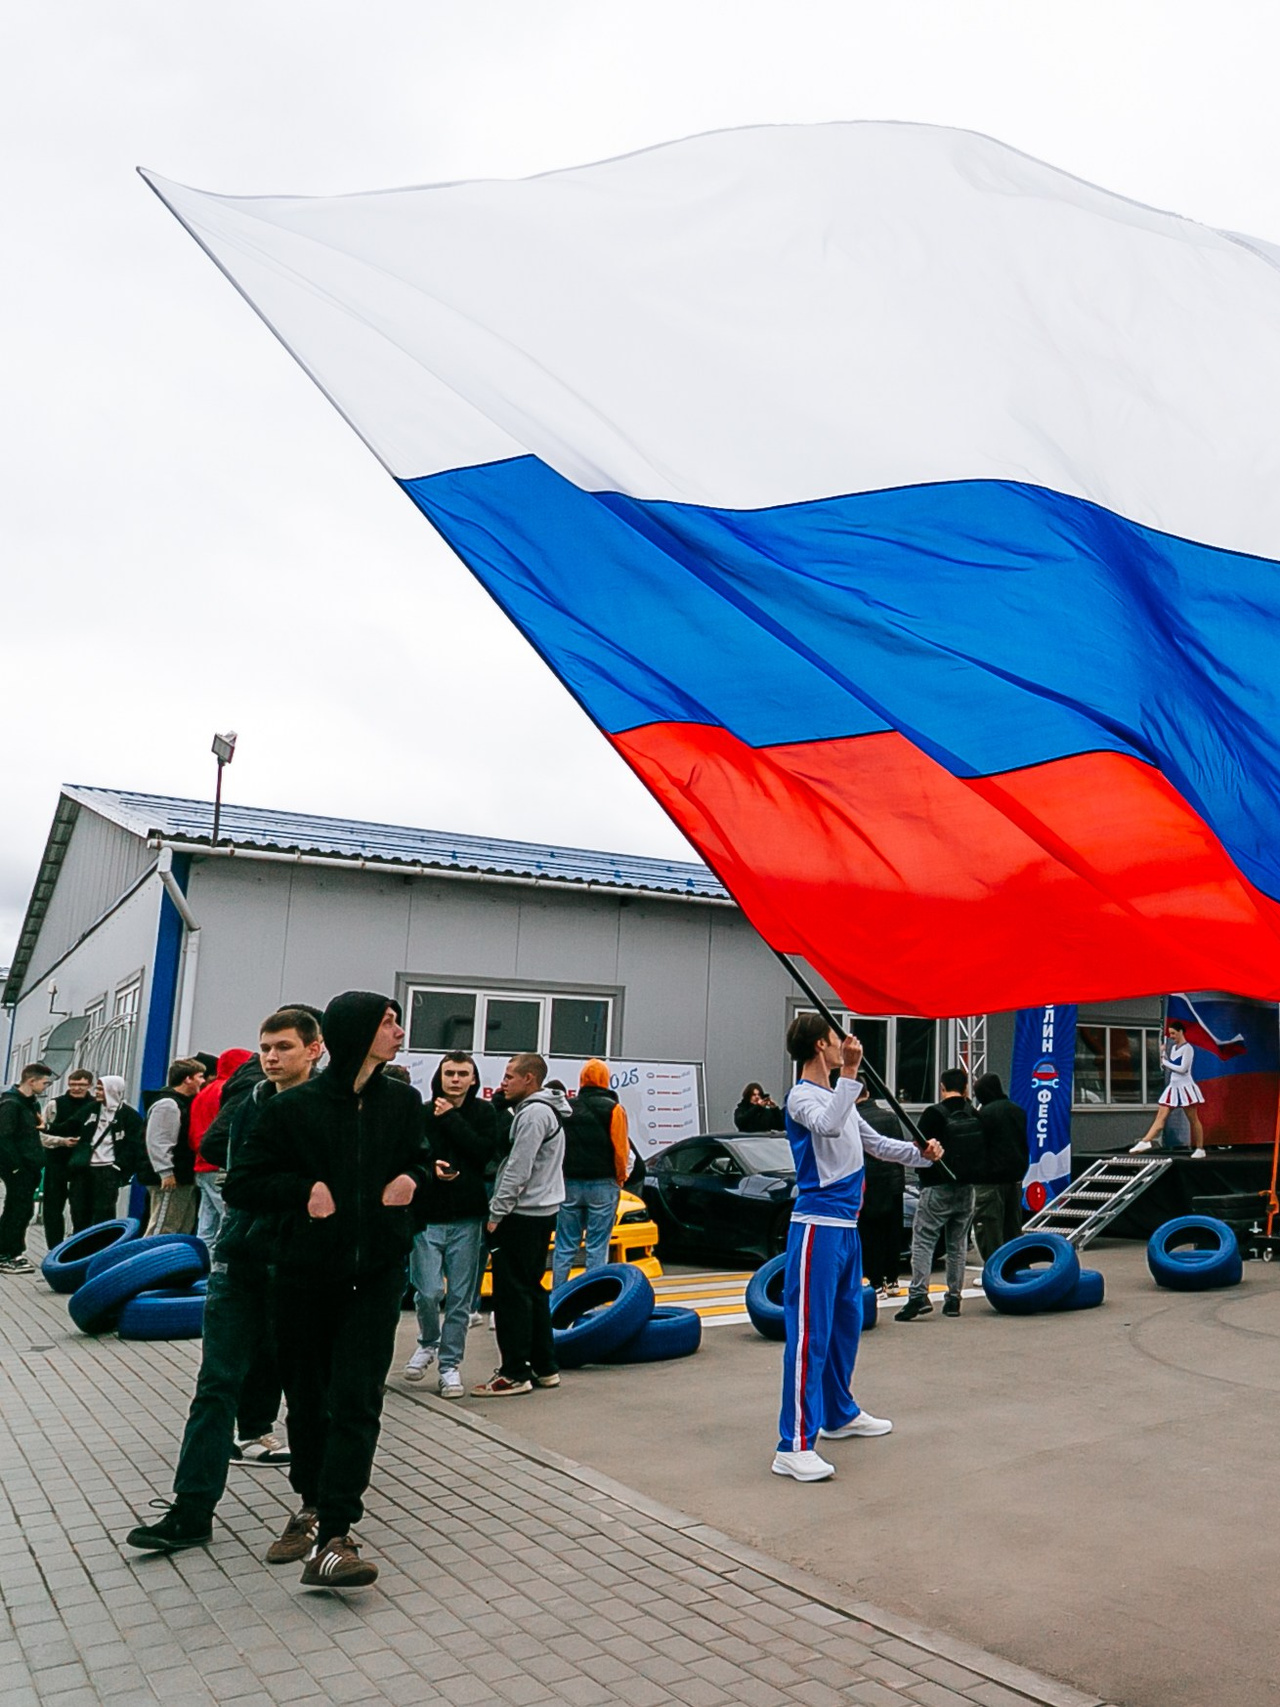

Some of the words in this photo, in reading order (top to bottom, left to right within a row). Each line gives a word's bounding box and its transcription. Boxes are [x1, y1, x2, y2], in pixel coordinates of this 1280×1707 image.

[1042, 1005, 1054, 1053] ЛИН
[610, 1067, 639, 1089] 025
[1037, 1089, 1051, 1148] ФЕСТ
